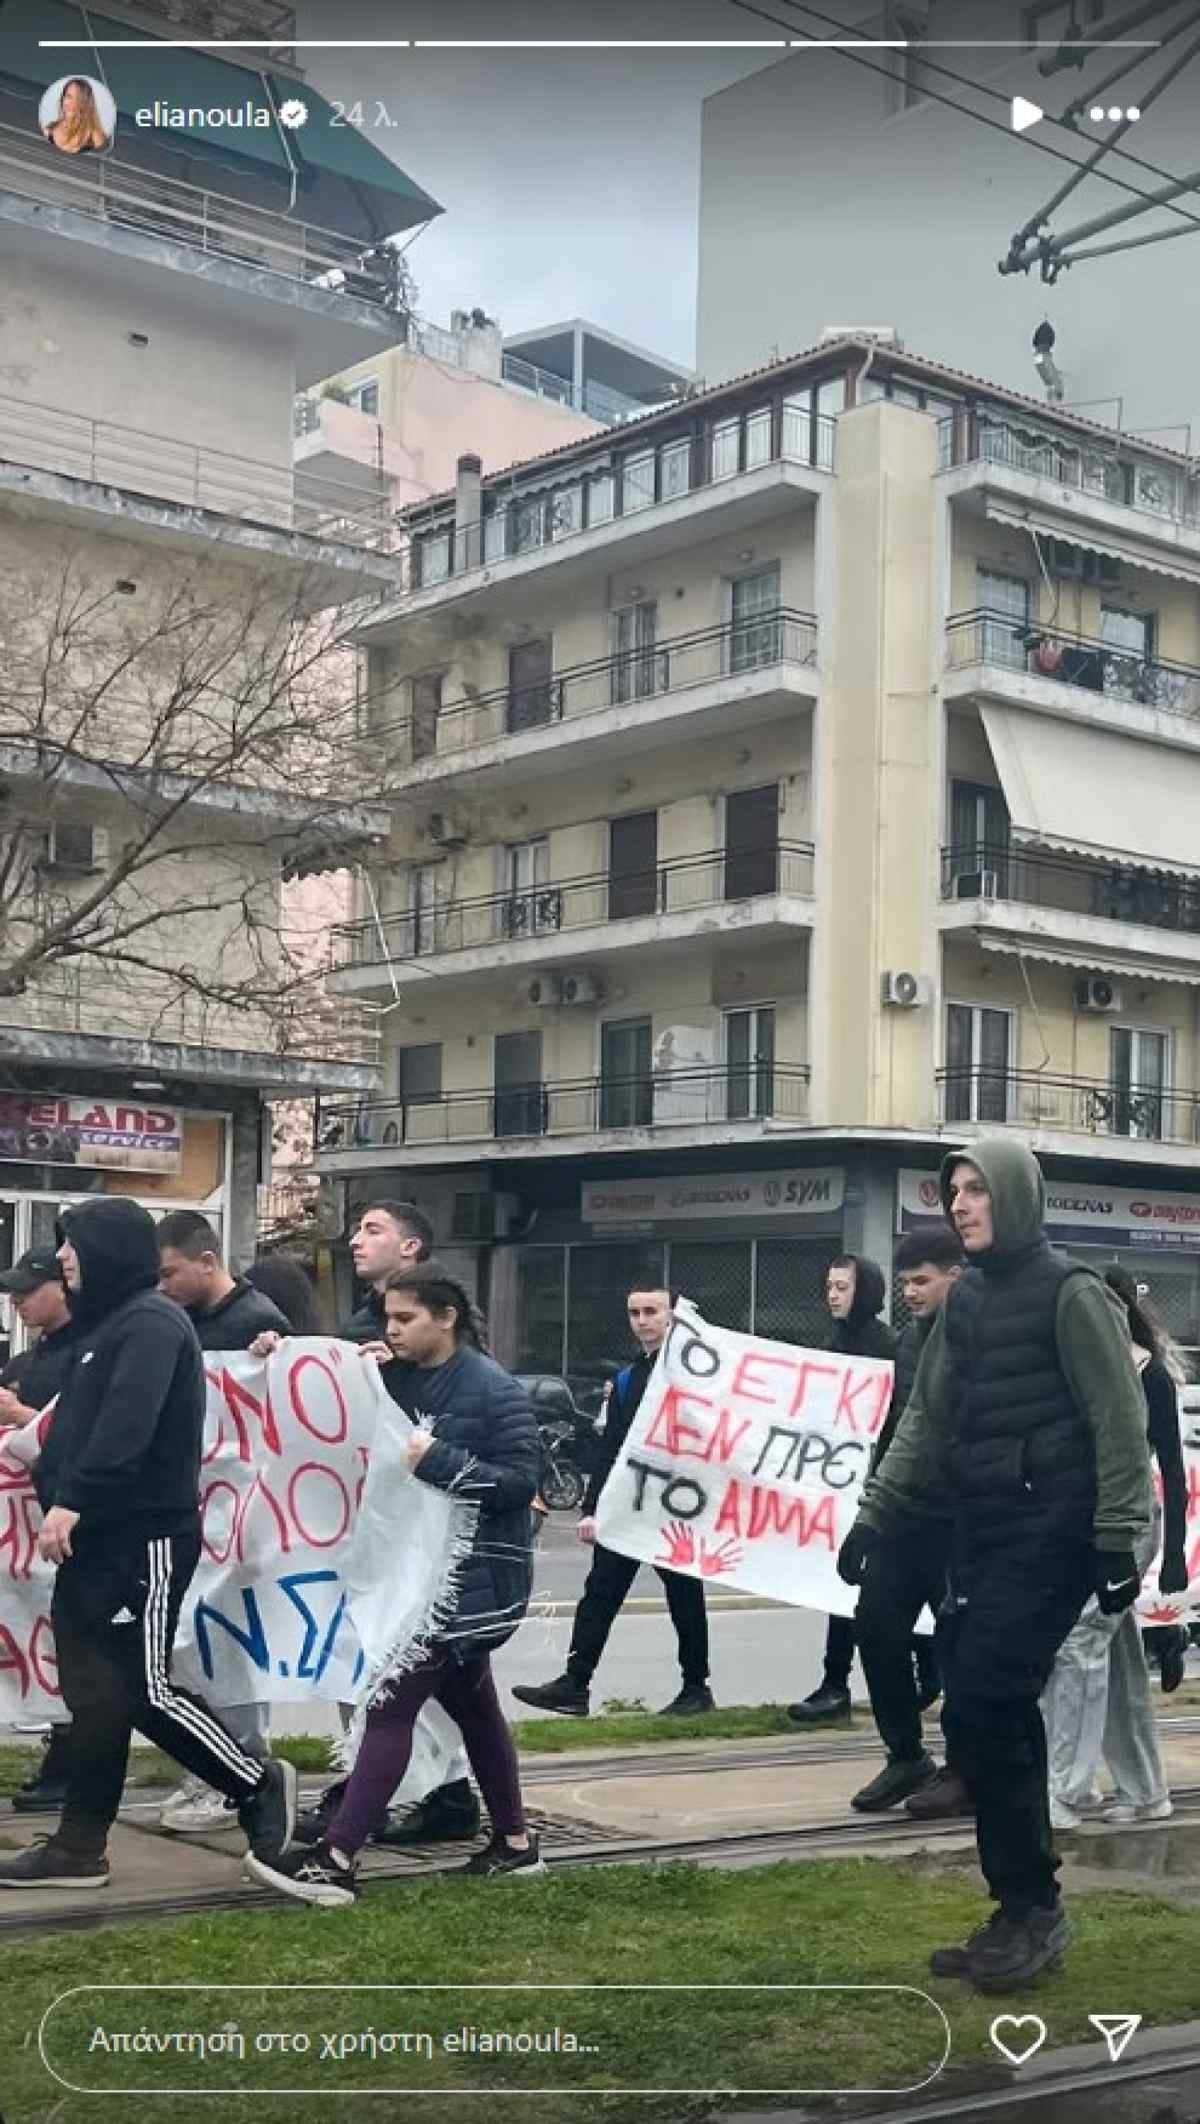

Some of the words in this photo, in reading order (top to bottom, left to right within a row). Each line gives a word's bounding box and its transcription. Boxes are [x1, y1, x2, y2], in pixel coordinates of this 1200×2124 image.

[784, 1179, 830, 1204] SYM
[644, 1384, 751, 1464] ΔΕΝ
[627, 1457, 708, 1518] ΤΟ
[714, 1478, 836, 1552] ΑΙΜΑ
